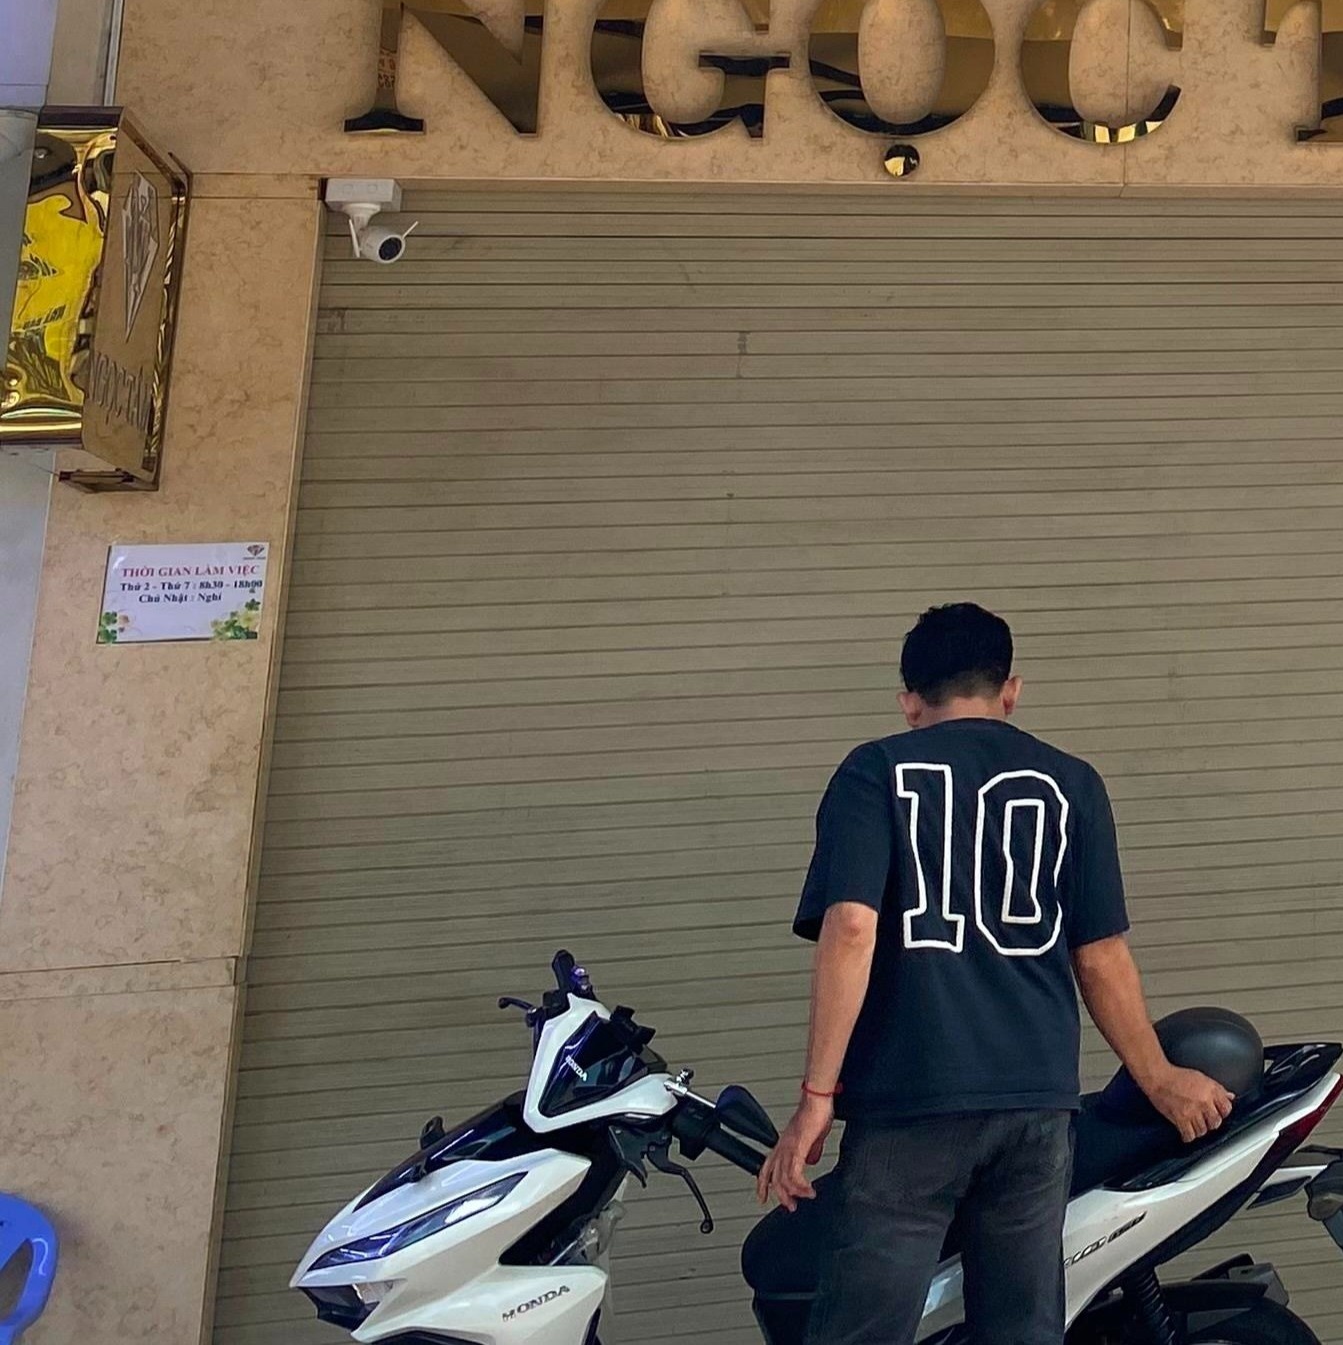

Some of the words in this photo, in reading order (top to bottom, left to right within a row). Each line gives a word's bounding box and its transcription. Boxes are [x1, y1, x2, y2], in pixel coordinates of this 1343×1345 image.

[123, 565, 155, 577] THỜI
[159, 566, 191, 577] GIAN
[195, 564, 224, 575] LÀM
[228, 564, 259, 576] VIỆC
[144, 582, 150, 591] 2
[185, 582, 191, 590] 7
[199, 580, 224, 590] 8h30
[895, 762, 1069, 957] 10
[502, 1285, 571, 1323] HONDA
